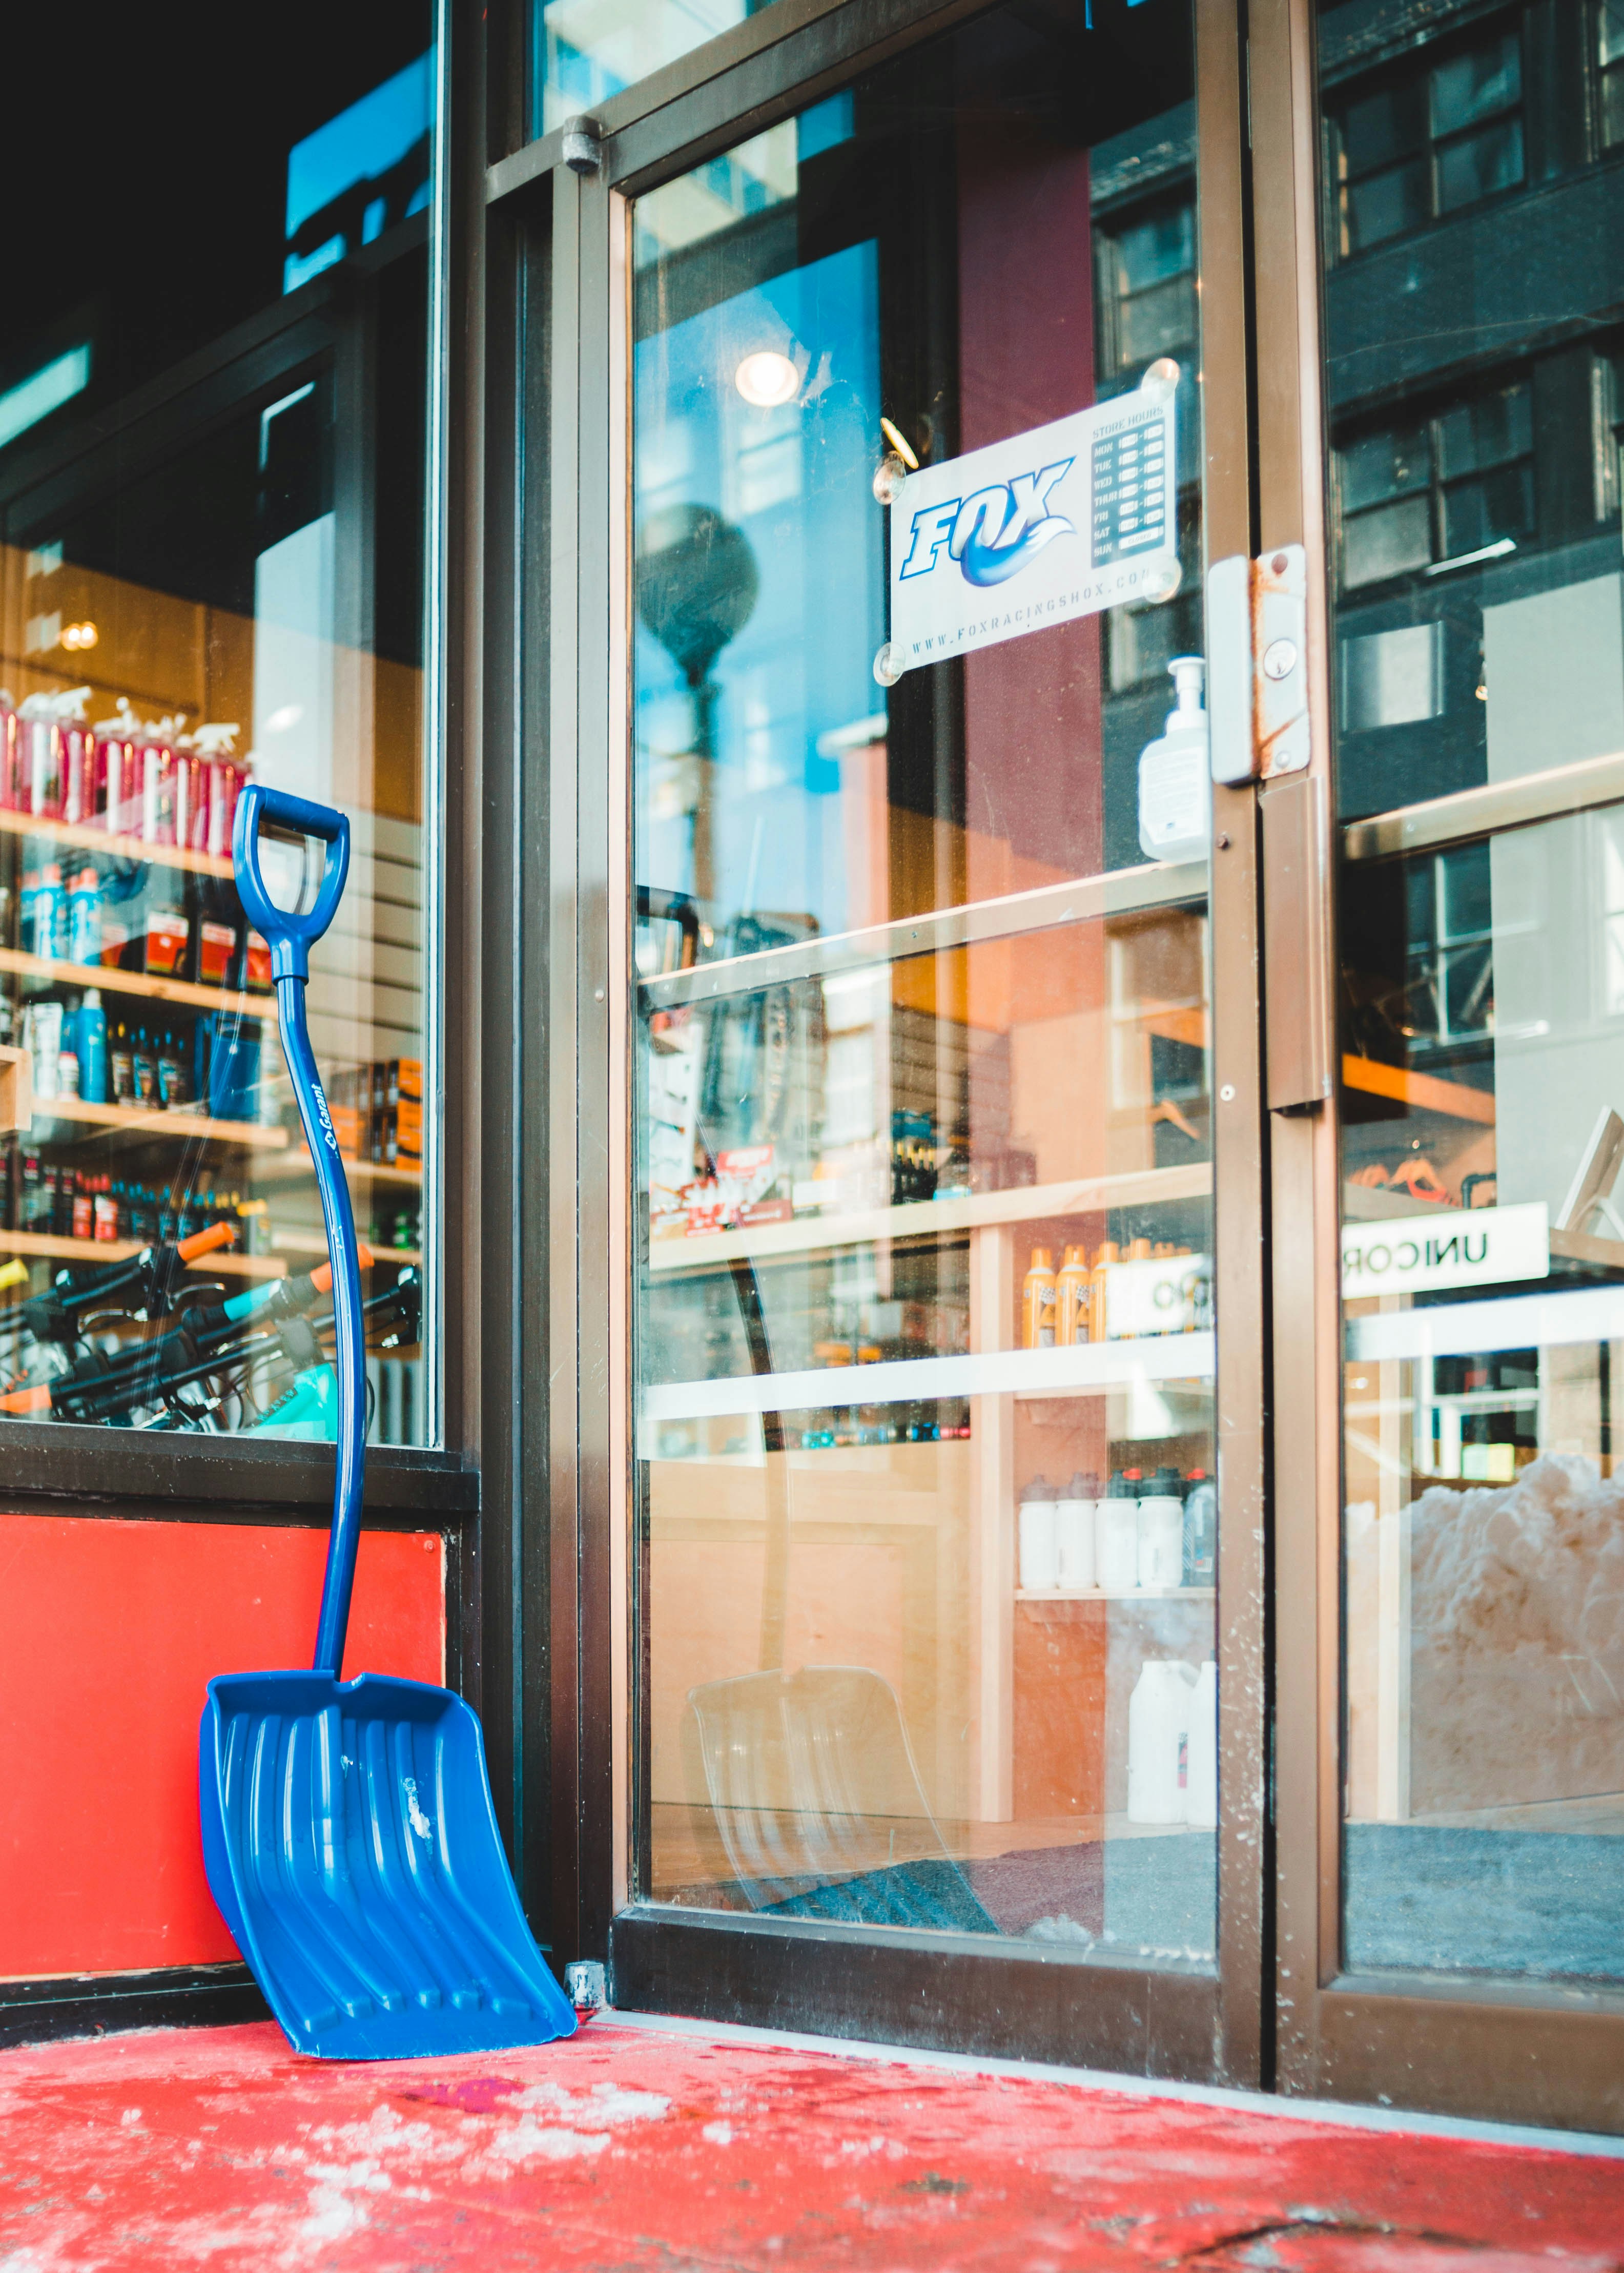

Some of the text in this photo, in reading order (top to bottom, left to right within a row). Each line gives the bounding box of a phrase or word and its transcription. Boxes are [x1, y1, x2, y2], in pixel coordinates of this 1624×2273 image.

[1093, 418, 1124, 439] STORE
[1128, 405, 1163, 425] HOURS
[1094, 442, 1113, 459] MON
[1094, 459, 1112, 474] TUE
[1094, 476, 1112, 490] WED
[1094, 490, 1118, 507] THUR
[899, 455, 1077, 582] FOX
[1094, 510, 1108, 525] FRI
[1094, 526, 1111, 541] SAT
[1094, 543, 1113, 557] SUN
[311, 1083, 333, 1130] Garant
